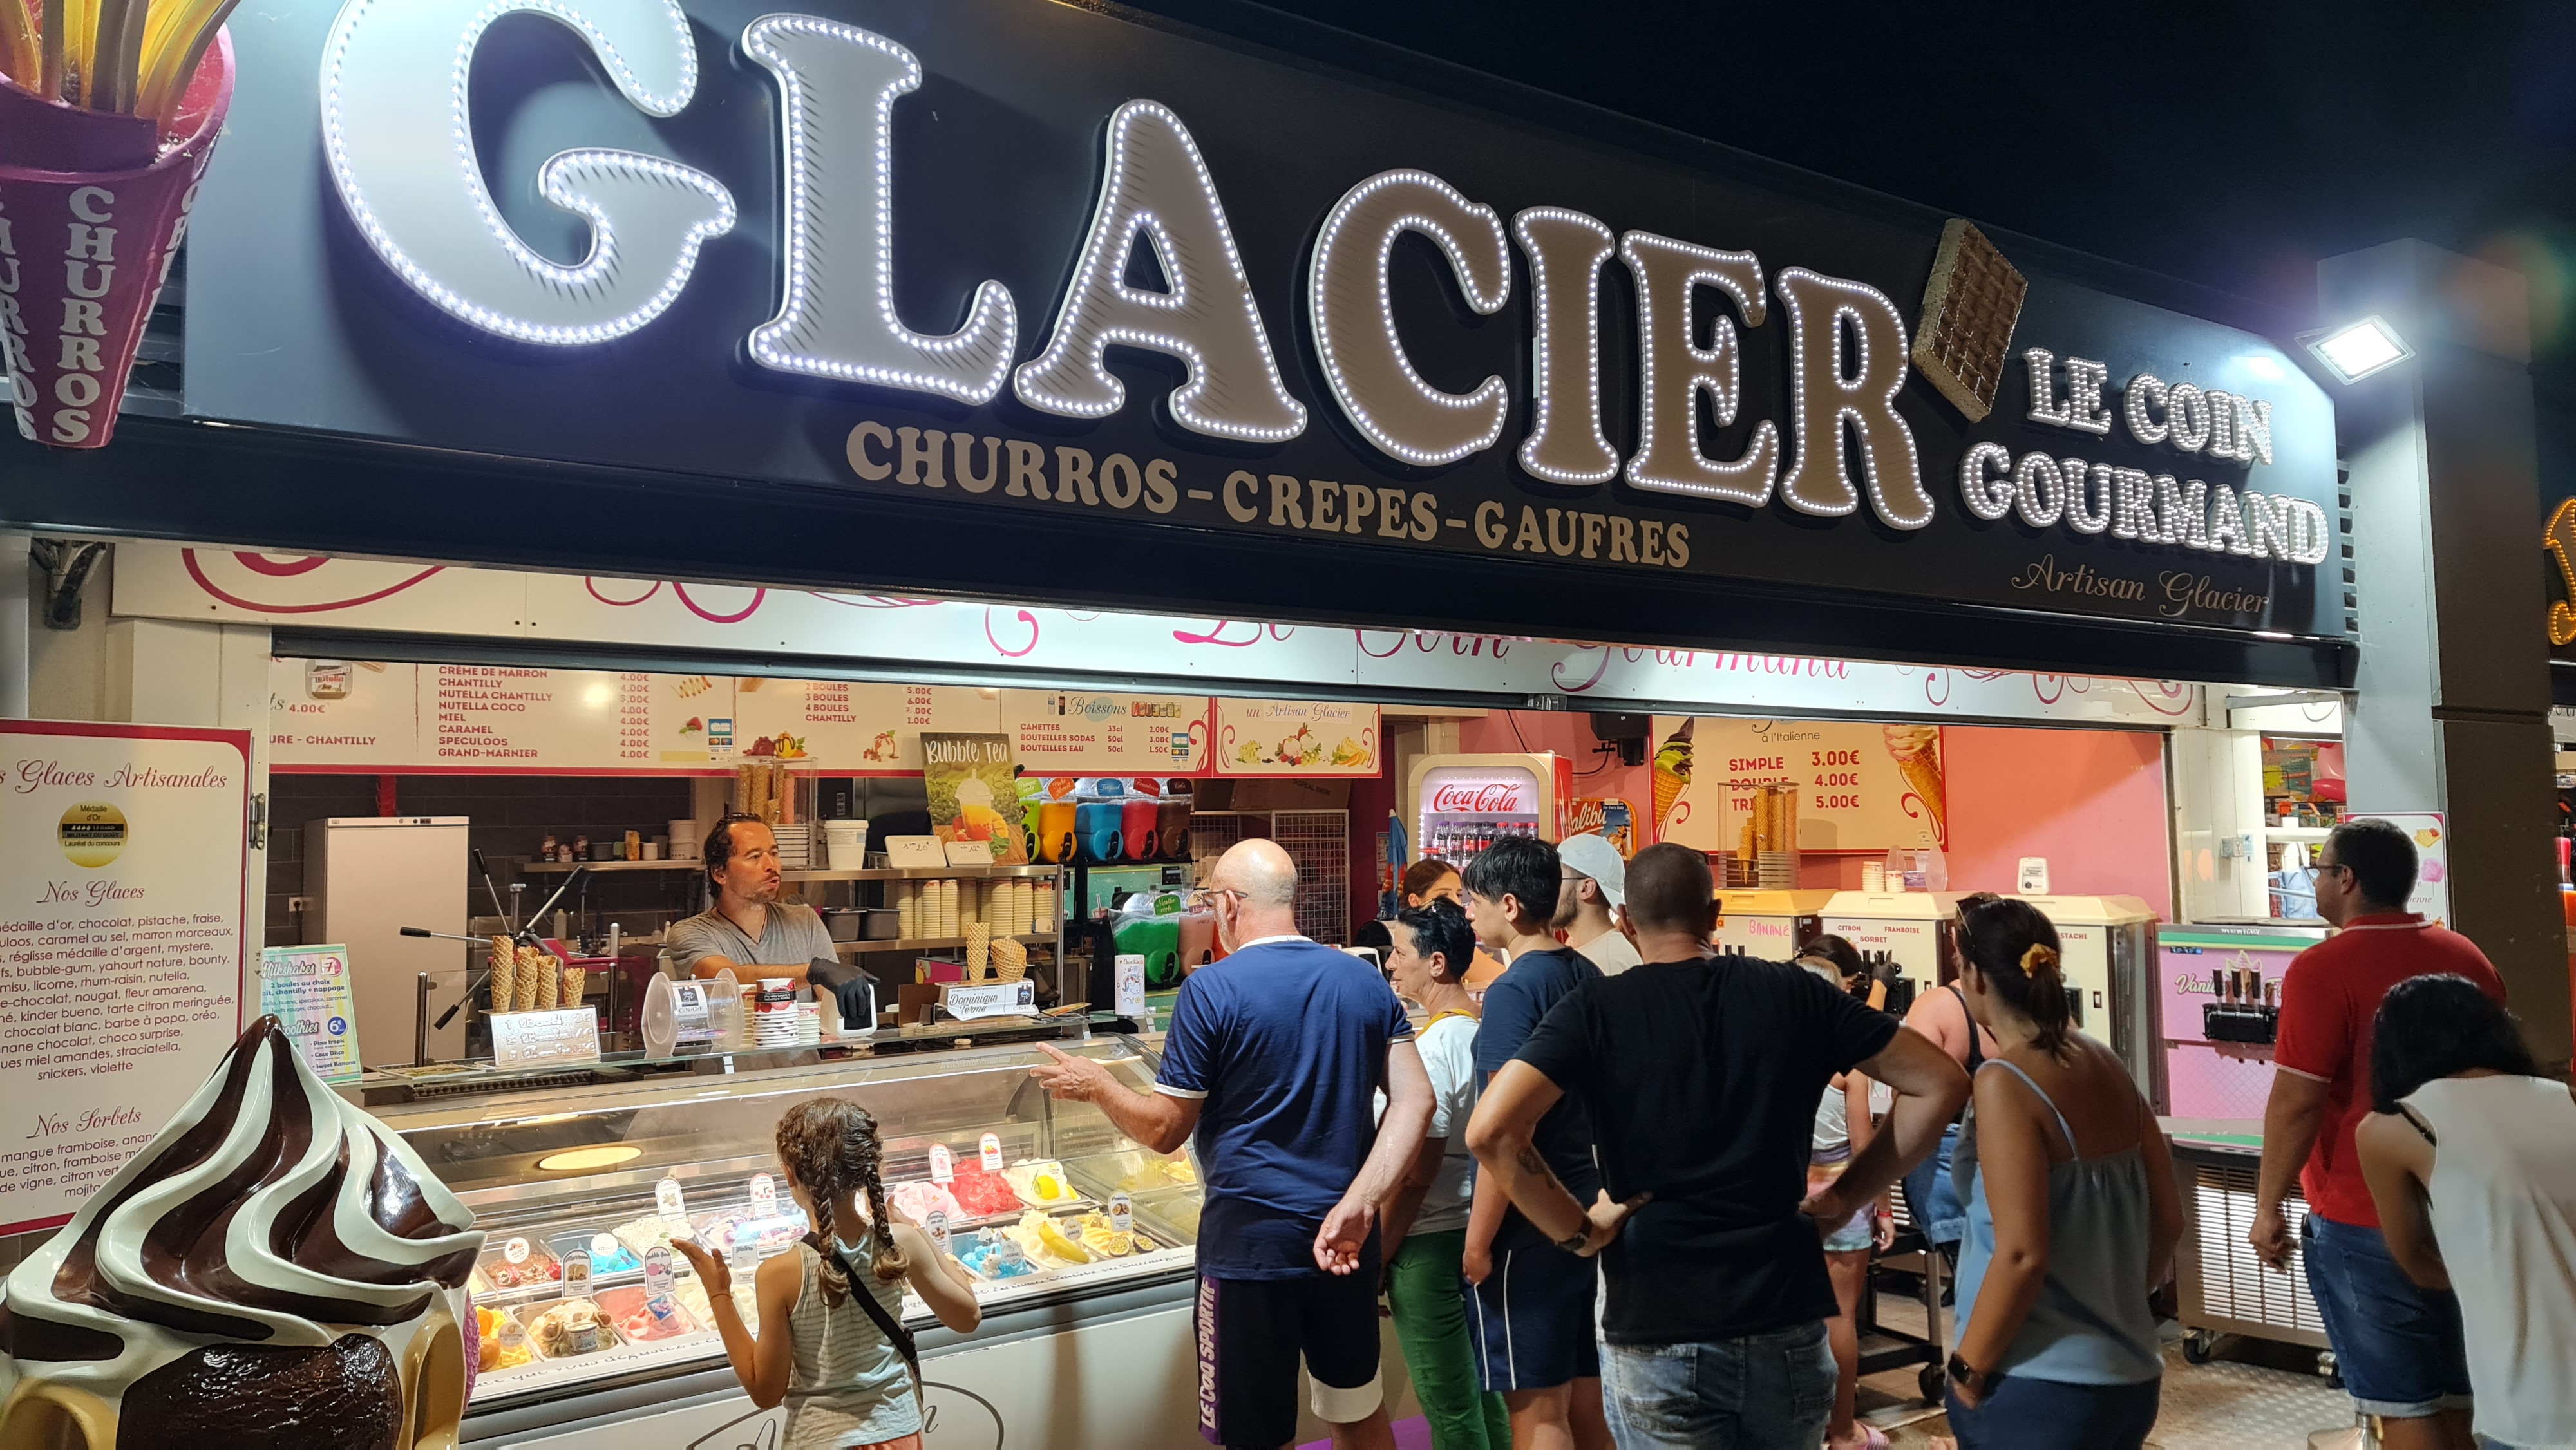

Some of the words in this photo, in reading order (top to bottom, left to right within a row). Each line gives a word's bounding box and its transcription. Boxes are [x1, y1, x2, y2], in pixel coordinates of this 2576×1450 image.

[322, 0, 1935, 529] GLACIER
[52, 186, 117, 443] CHURROS
[2023, 347, 2112, 434] LE
[2125, 372, 2273, 465] COIN
[1960, 442, 2329, 565] GOURMAND
[2012, 554, 2145, 601] Artisan
[2159, 570, 2269, 617] Glacier
[439, 678, 502, 688] CHANTILLY
[481, 668, 495, 676] DE
[499, 669, 547, 678] MARRON
[620, 673, 649, 682] 4.00€
[439, 690, 488, 699] NUTELLA
[491, 692, 553, 701] CHANTILLY
[1068, 696, 1127, 715] Boissons
[289, 704, 325, 713] 4.00€
[439, 702, 488, 711] NUTELLA
[491, 703, 525, 711] COCO
[1247, 708, 1260, 717] un
[1265, 702, 1307, 717] Artisan
[1311, 703, 1350, 721] Glacier
[439, 713, 466, 722] MIEL
[620, 717, 649, 726] 4.00€
[806, 714, 857, 722] CHANTILLY
[306, 735, 375, 745] CHANTILLY
[439, 725, 493, 734] CARAMEL
[620, 728, 649, 737] 4.00€
[1761, 733, 1768, 742] à
[1771, 731, 1820, 742] l'Italienne
[439, 737, 507, 746] SPECULOOS
[438, 748, 538, 758] GRAND-MARNIER
[620, 750, 649, 758] 4.00€
[925, 740, 979, 764] Bubble
[983, 742, 1008, 763] Tea
[1729, 757, 1784, 771] SIMPLE
[1812, 749, 1860, 766] 3.00€
[15, 759, 95, 794] Glaces
[103, 762, 227, 789] Artisanales
[1815, 773, 1858, 786] 4.00€
[1434, 784, 1522, 812] Coca-Cola
[1816, 795, 1859, 808] 5.00€
[36, 880, 79, 903] Nos
[85, 880, 145, 907] Glaces
[78, 917, 135, 928] chocolat,
[138, 915, 189, 928] pistache,
[193, 914, 223, 923] fraise,
[1749, 919, 1790, 937] BANANE
[38, 934, 88, 945] caramel
[91, 934, 107, 943] au
[111, 932, 128, 942] sel,
[132, 931, 172, 940] marron
[175, 928, 233, 938] morceaux,
[9, 950, 52, 963] réglisse
[56, 947, 107, 959] médaille
[111, 944, 164, 957] d'argent,
[167, 942, 213, 954] mystere,
[17, 965, 95, 977] bubble-gum,
[99, 959, 144, 974] yahourt
[146, 958, 185, 968] nature,
[189, 954, 230, 966] bounty,
[33, 980, 77, 990] licorne,
[80, 974, 146, 987] rhum-raisin,
[149, 970, 190, 982] nutella,
[276, 987, 307, 995] chantilly
[314, 985, 345, 994] nappage
[75, 990, 121, 1003] nougat,
[125, 988, 149, 999] fleur
[152, 985, 207, 996] amarena,
[949, 993, 998, 1006] Dominique
[21, 1010, 58, 1021] kinder
[61, 1007, 104, 1018] bueno,
[107, 1003, 134, 1014] tarte
[137, 1001, 169, 1012] citron
[173, 995, 234, 1009] meringuée,
[4, 1024, 60, 1038] chocolat
[64, 1022, 101, 1033] blanc,
[105, 1017, 140, 1029] barbe
[143, 1015, 151, 1025] à
[155, 1014, 188, 1026] papa,
[192, 1010, 220, 1021] oréo,
[37, 1035, 95, 1050] chocolat,
[99, 1033, 137, 1044] choco
[140, 1028, 184, 1040] surprise,
[25, 1054, 50, 1067] miel
[53, 1049, 113, 1063] amandes,
[117, 1042, 182, 1057] straciatella,
[37, 1068, 87, 1080] snickers,
[90, 1061, 133, 1073] violette
[26, 1113, 69, 1139] Nos
[75, 1106, 142, 1132] Sorbets
[1, 1147, 53, 1163] mangue
[57, 1138, 118, 1154] framboise,
[22, 1162, 60, 1174] citron,
[64, 1152, 121, 1168] framboise
[20, 1176, 56, 1191] vigne,
[60, 1170, 93, 1183] citron
[1199, 1276, 1215, 1361] SPORTIF
[1200, 1361, 1215, 1402] COQ
[1202, 1400, 1215, 1429] LE
